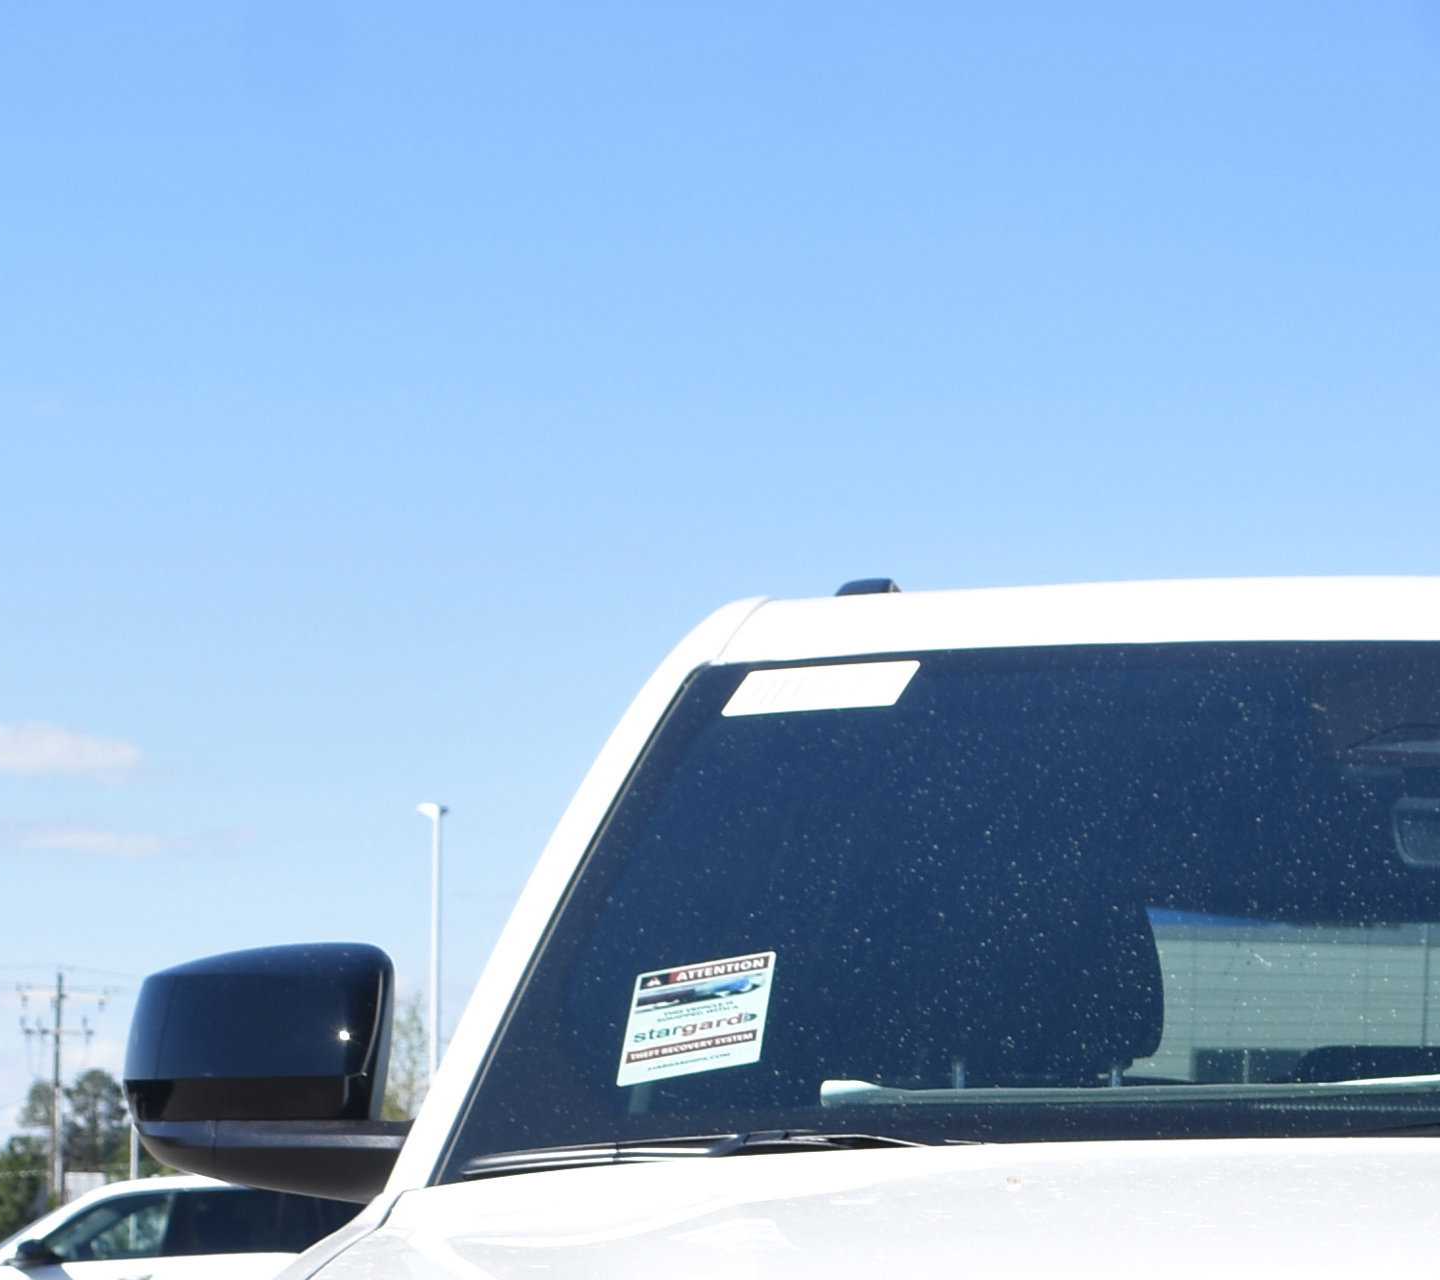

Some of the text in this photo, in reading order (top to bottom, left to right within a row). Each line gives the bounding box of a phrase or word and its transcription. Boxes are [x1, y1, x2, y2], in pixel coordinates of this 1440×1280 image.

[676, 958, 765, 982] ATTENTION
[633, 1013, 743, 1043] stargard
[630, 1032, 754, 1061] THEFT RECOVERY SYSTEM
